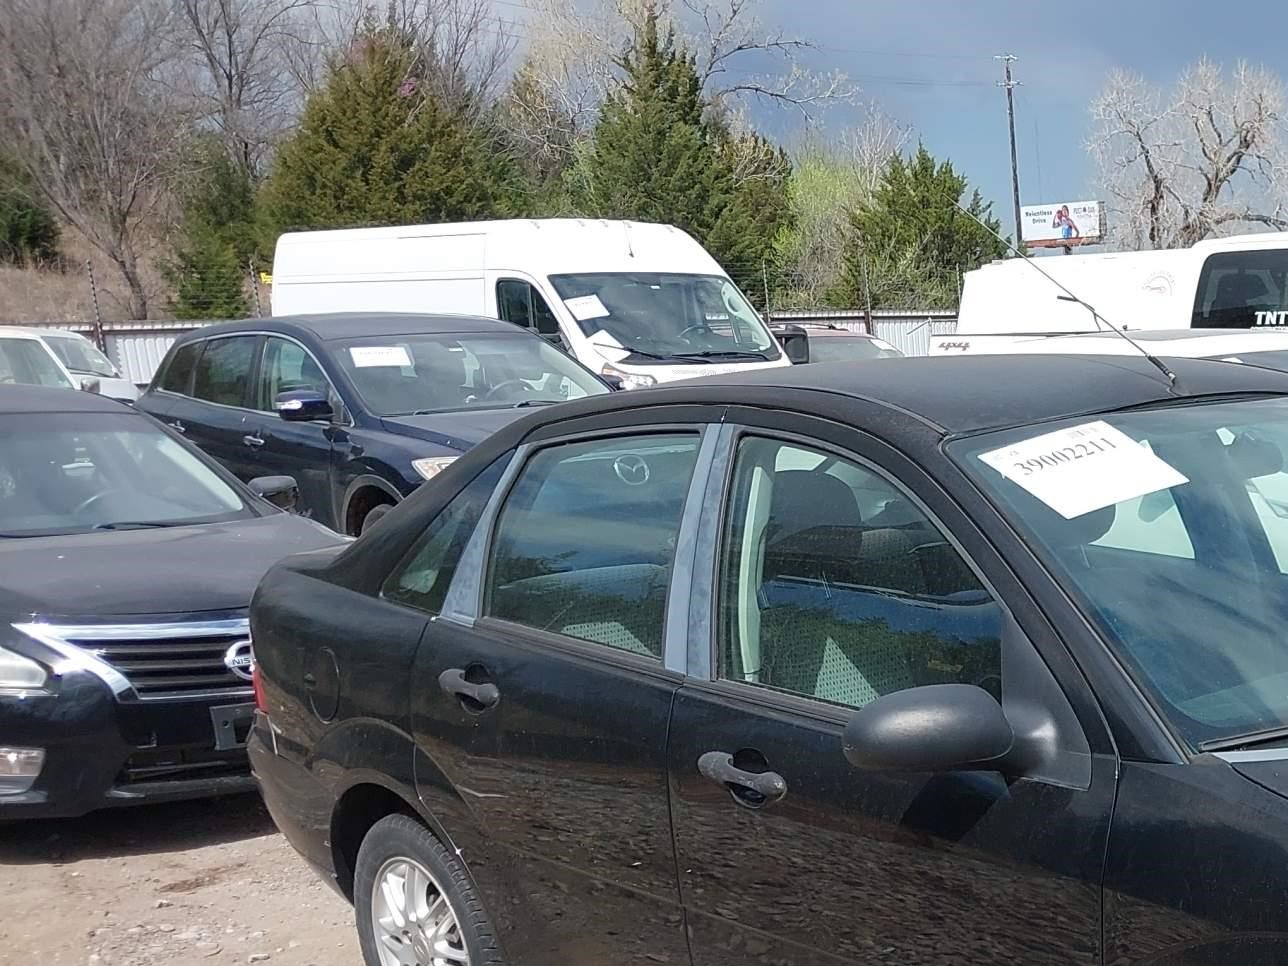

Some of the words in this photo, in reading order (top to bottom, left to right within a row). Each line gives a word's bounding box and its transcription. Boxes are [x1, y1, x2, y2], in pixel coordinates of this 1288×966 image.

[1254, 310, 1288, 325] TNT
[1013, 437, 1117, 475] 39002211
[231, 657, 251, 665] NIS
